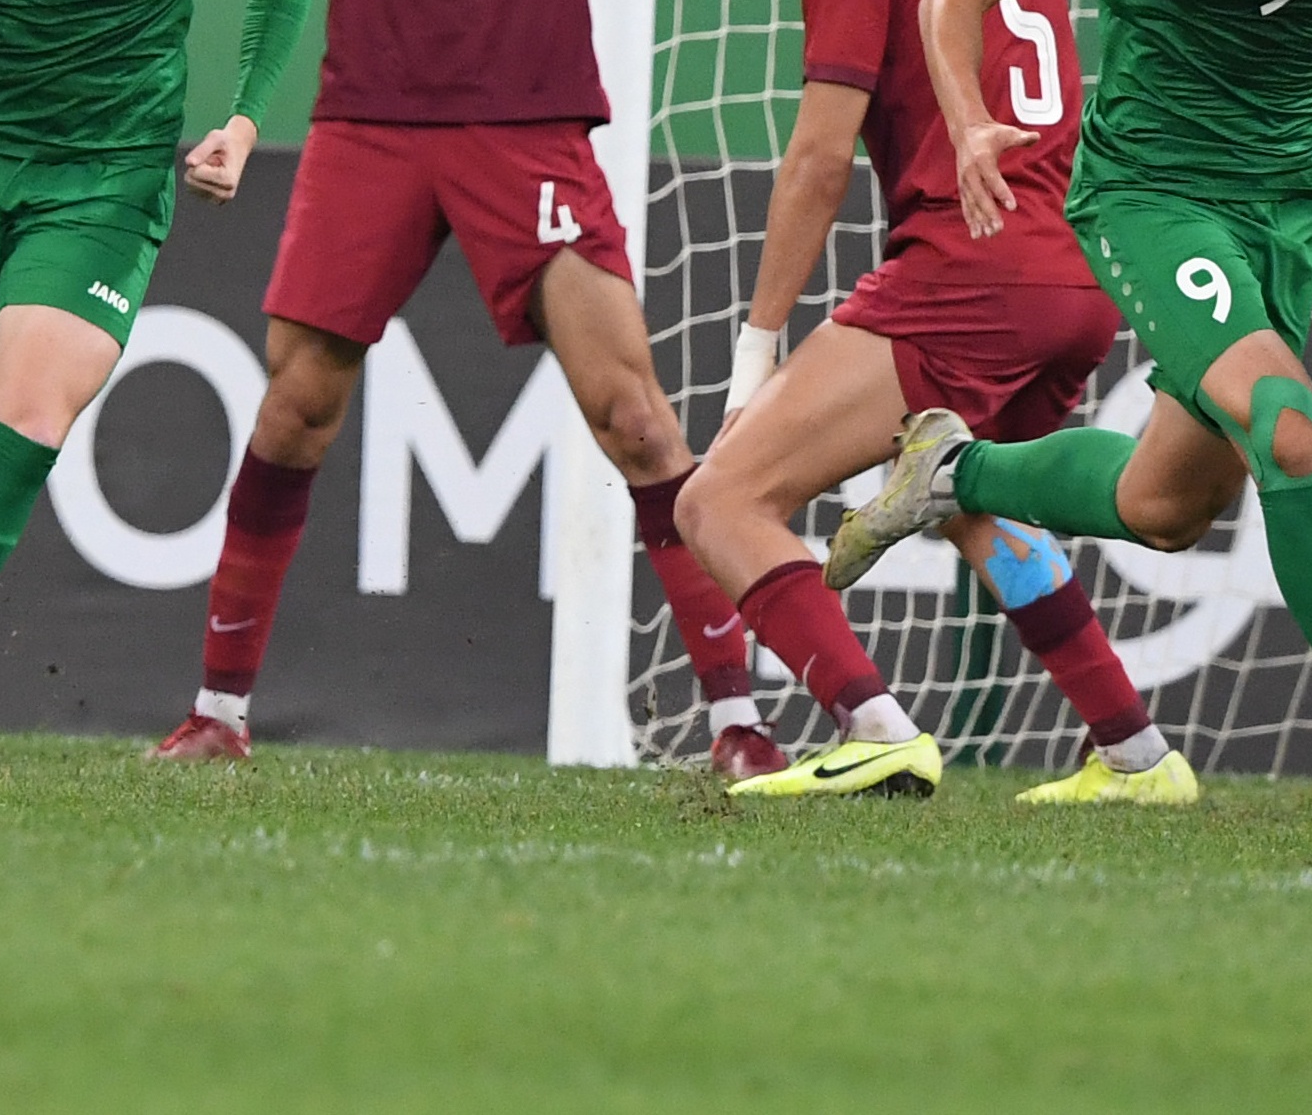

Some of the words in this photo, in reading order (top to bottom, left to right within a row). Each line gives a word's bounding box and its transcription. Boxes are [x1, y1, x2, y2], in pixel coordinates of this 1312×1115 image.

[537, 181, 582, 244] 4
[87, 280, 130, 315] JAKO
[1175, 256, 1233, 324] 9
